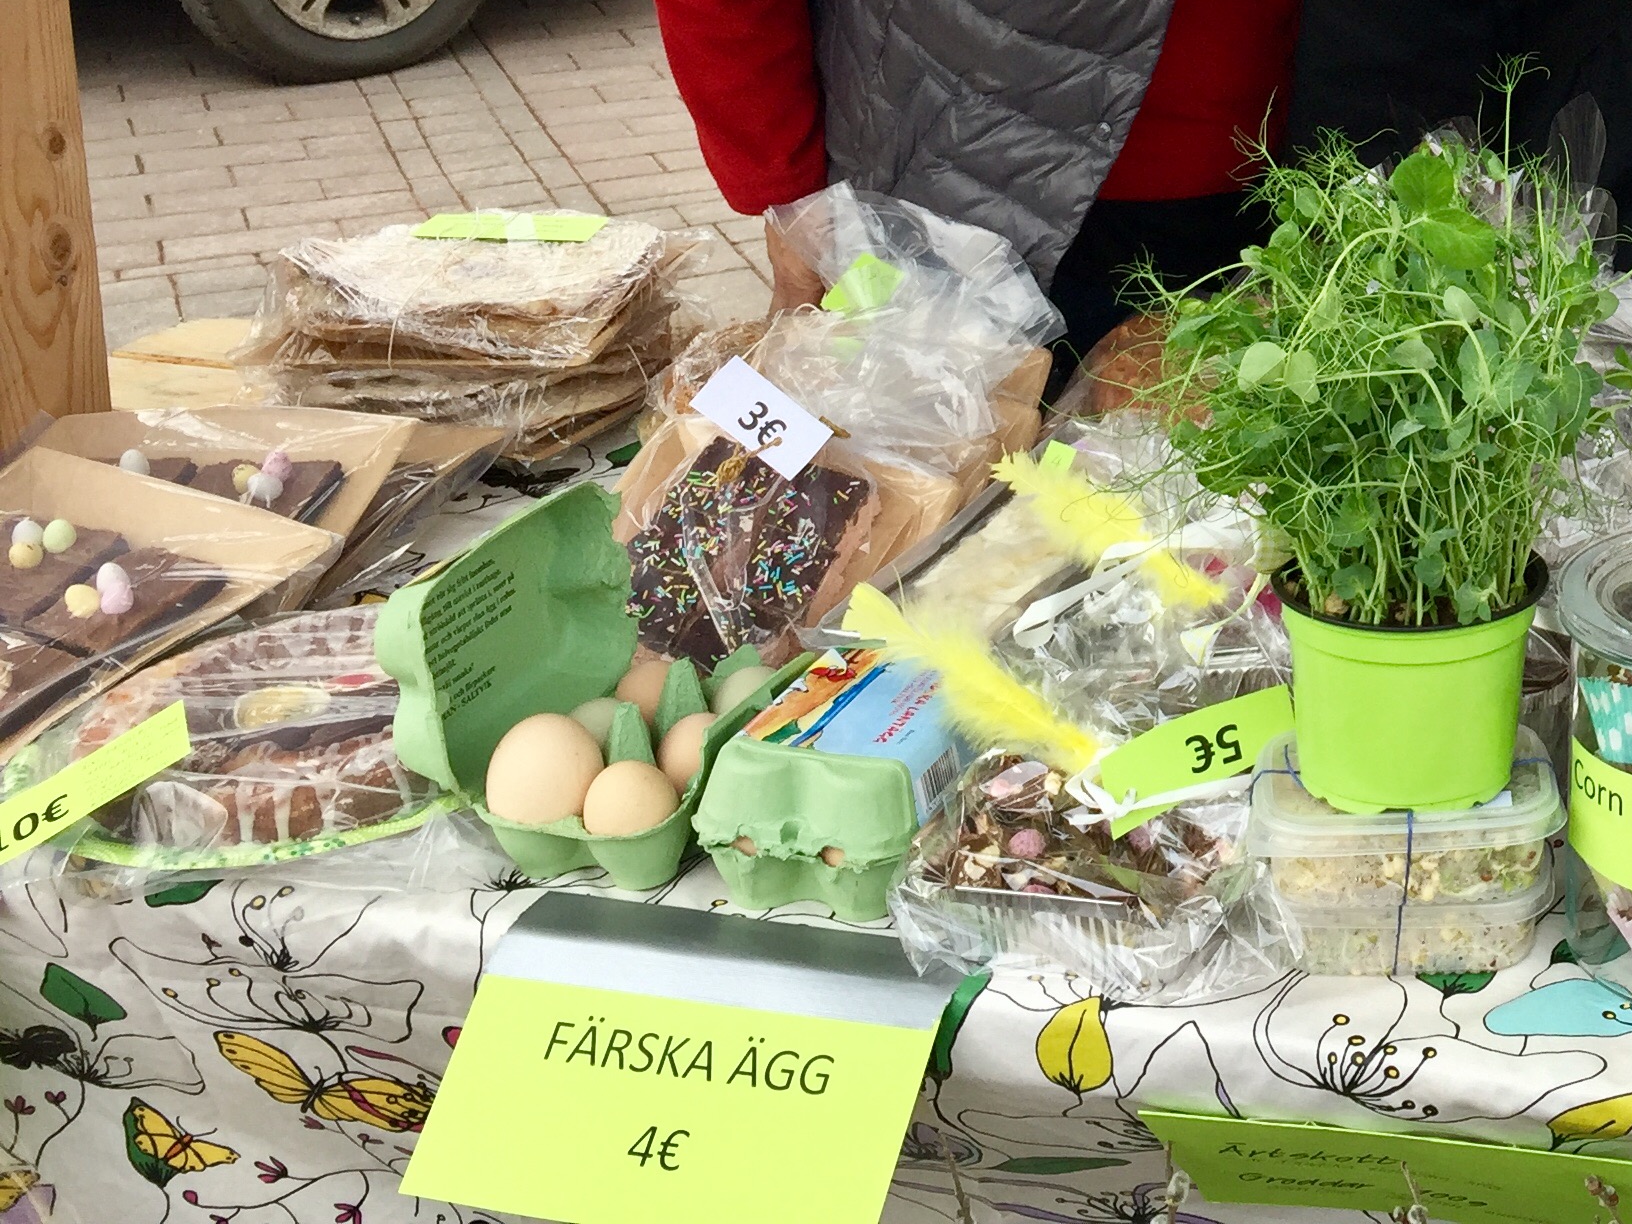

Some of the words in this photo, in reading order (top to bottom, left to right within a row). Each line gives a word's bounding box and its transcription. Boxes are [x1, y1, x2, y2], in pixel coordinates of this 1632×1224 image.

[737, 401, 787, 446] 3€
[1185, 724, 1242, 774] 5€
[1573, 758, 1624, 816] Corn
[543, 1014, 714, 1082] FÄRSKA
[726, 1035, 835, 1096] ÄGG
[627, 1125, 691, 1172] 4€
